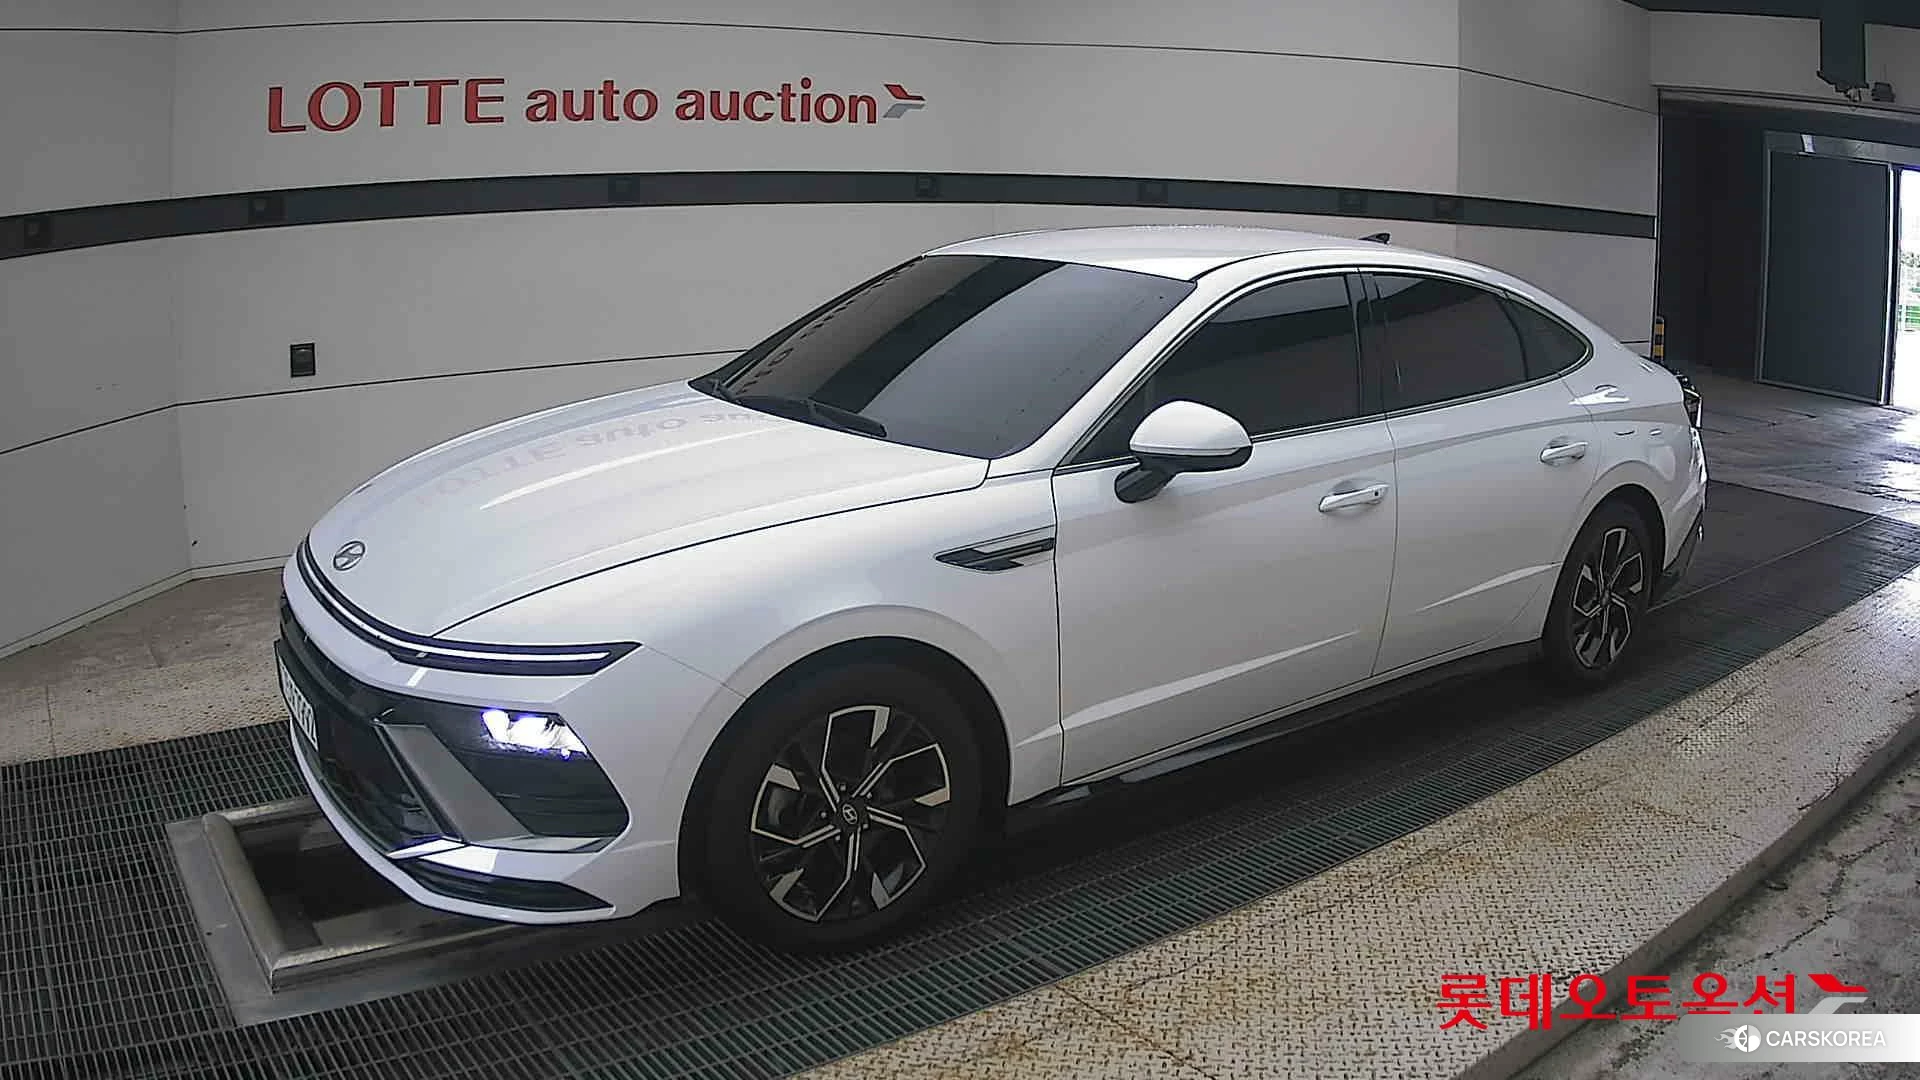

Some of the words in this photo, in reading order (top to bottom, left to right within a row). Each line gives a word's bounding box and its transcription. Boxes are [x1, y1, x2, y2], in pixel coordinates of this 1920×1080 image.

[268, 78, 504, 133] LOTTE
[525, 80, 658, 123] auto
[674, 78, 878, 125] auction
